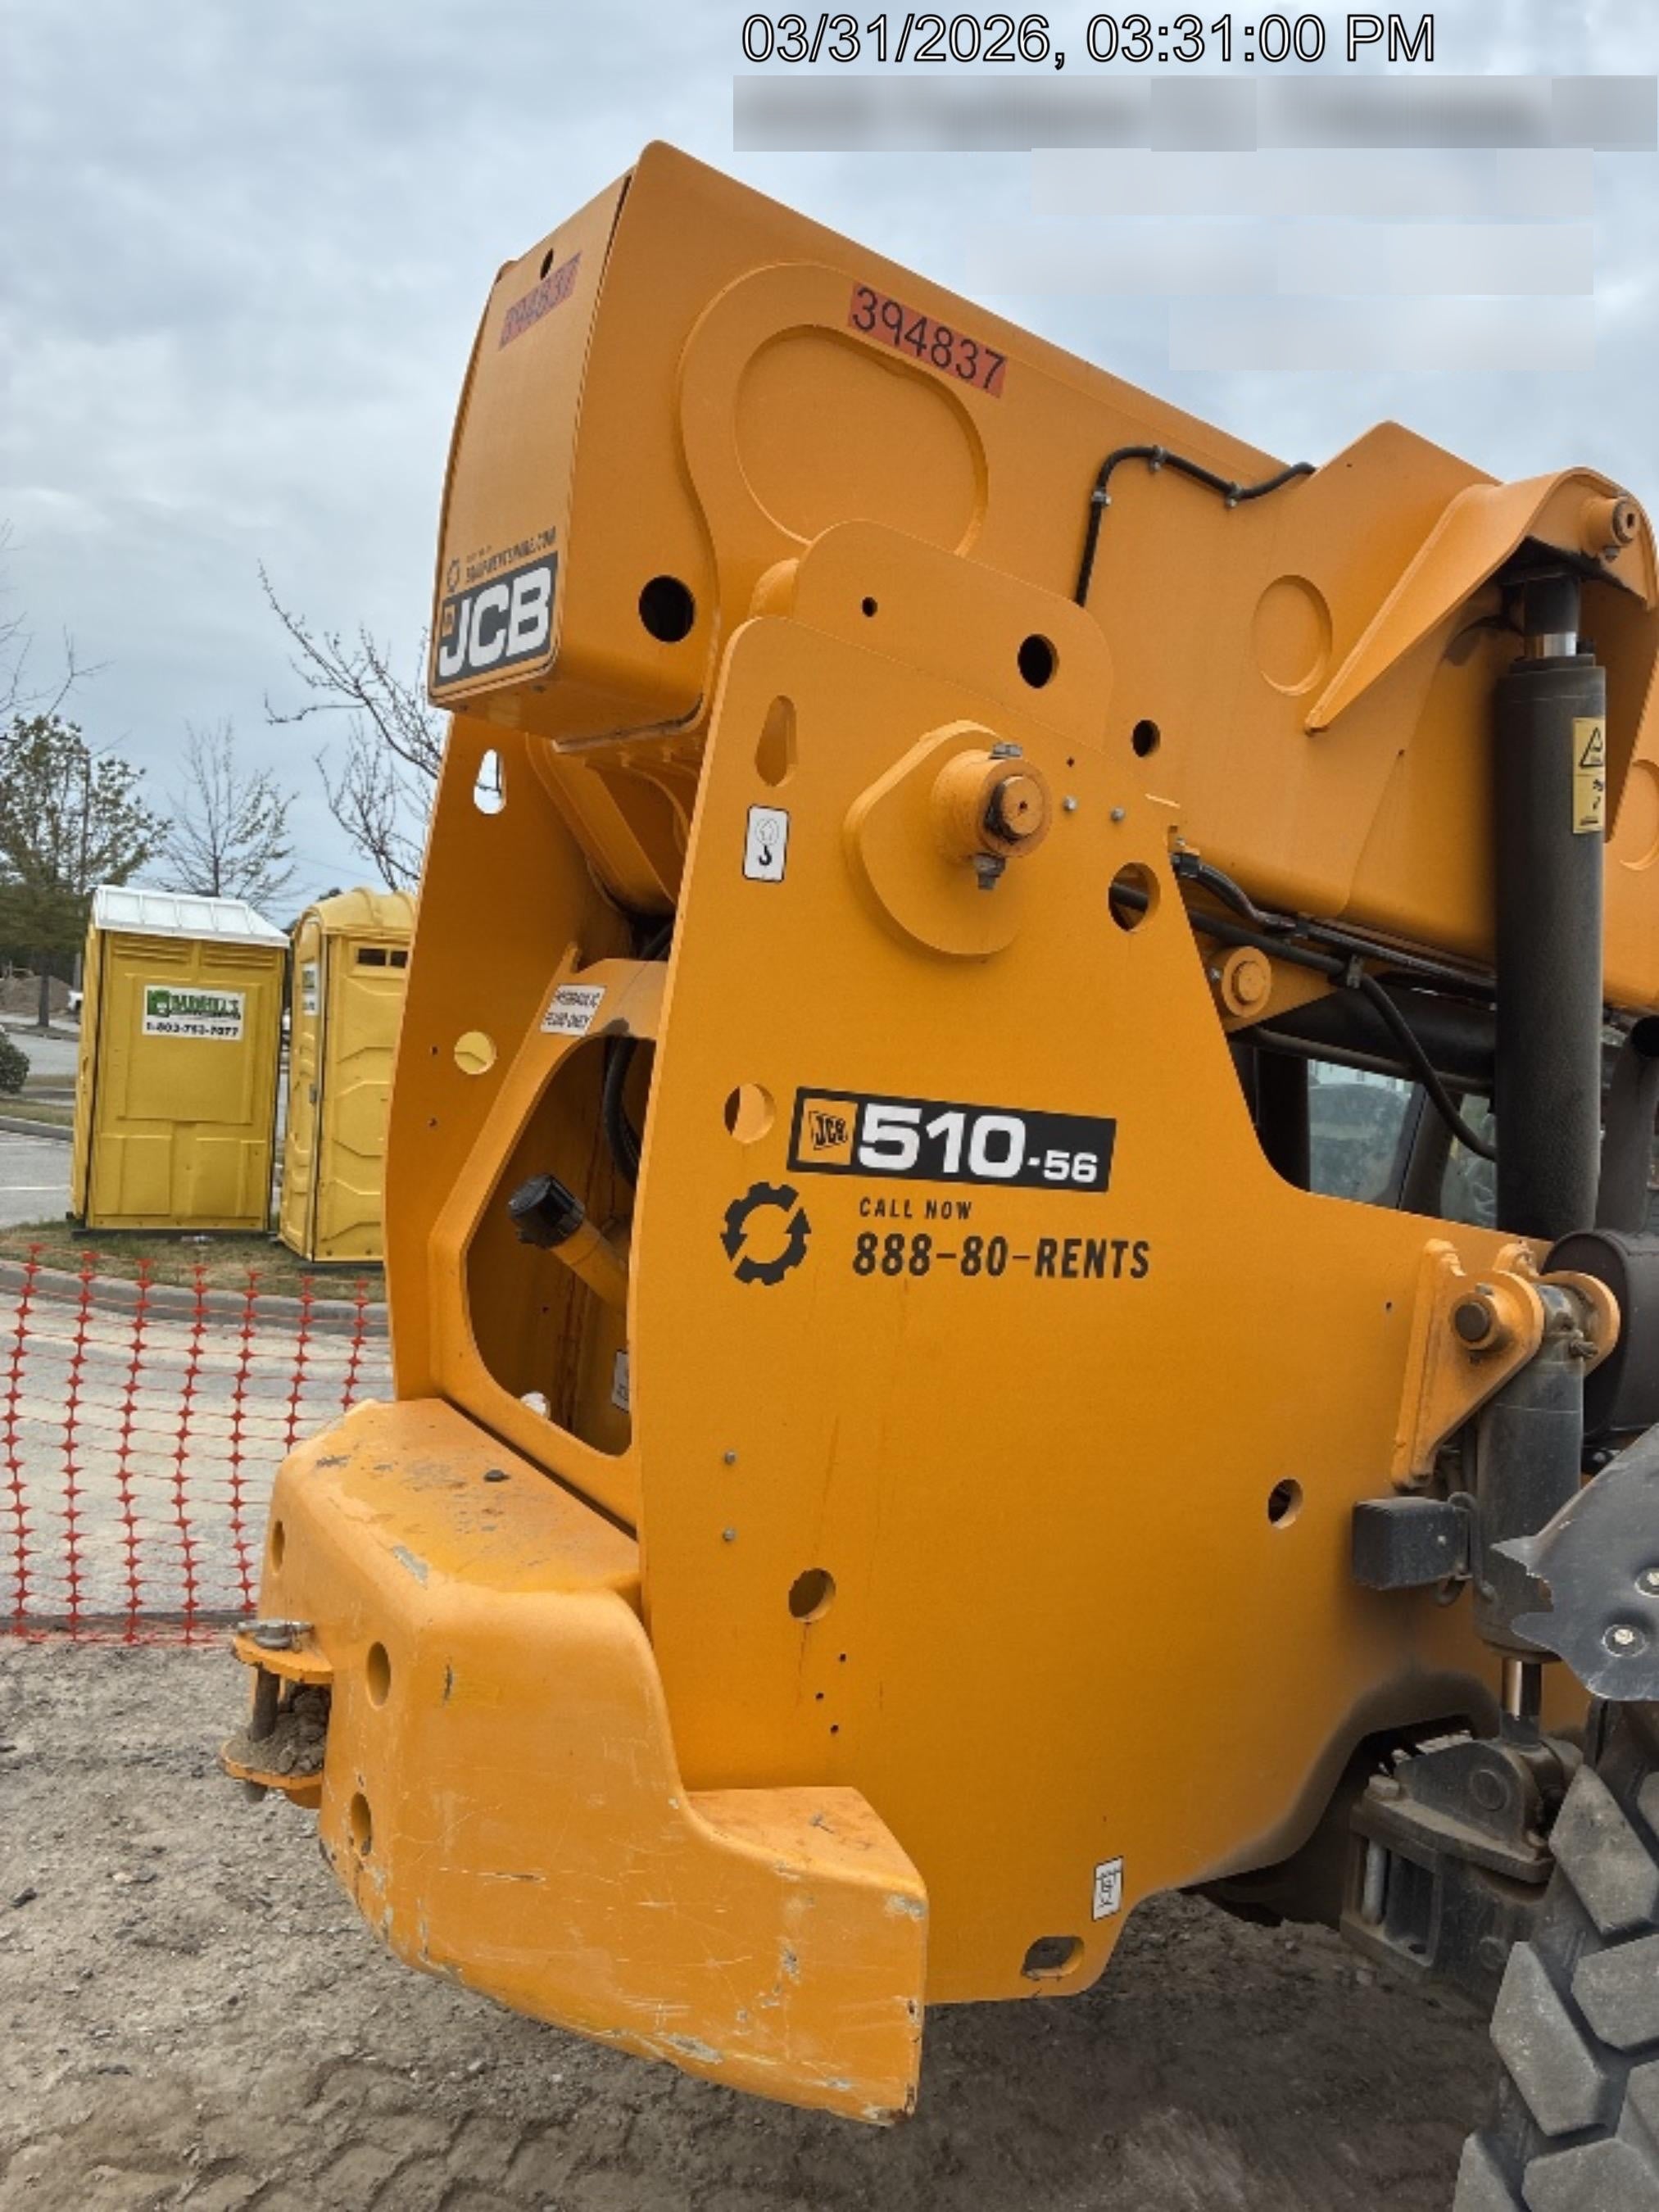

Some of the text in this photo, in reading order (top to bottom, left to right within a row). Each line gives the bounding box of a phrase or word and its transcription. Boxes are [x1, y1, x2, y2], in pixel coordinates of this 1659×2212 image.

[852, 287, 1006, 389] 394837
[438, 567, 551, 677] JCB
[858, 1103, 1098, 1183] 510-56
[859, 1197, 972, 1220] CALL NOW
[852, 1231, 1150, 1278] 888-80-RENTS
